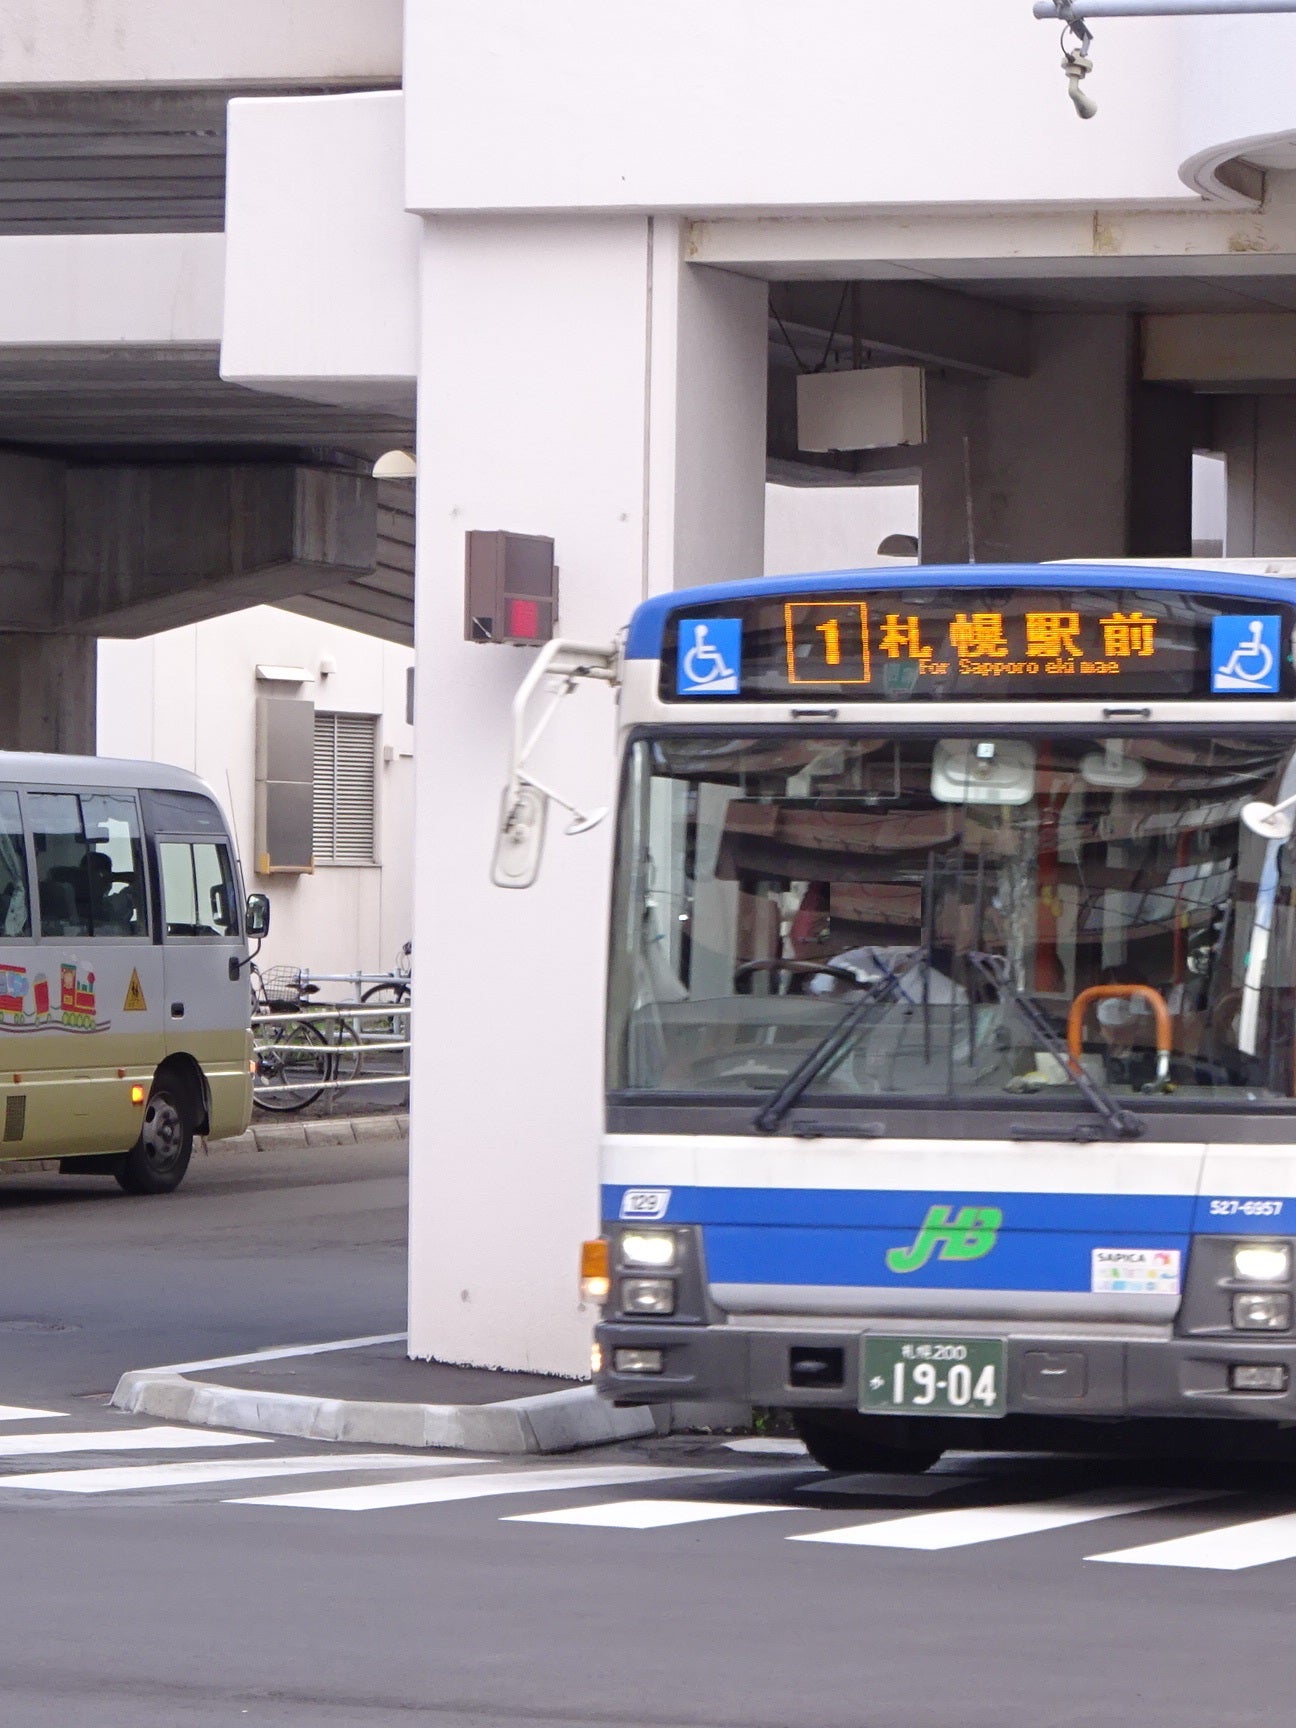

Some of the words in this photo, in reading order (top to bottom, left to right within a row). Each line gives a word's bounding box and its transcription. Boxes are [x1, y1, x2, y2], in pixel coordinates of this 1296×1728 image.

[815, 618, 841, 665] 1
[879, 612, 1158, 658] 札幌駅前
[918, 658, 951, 675] For
[958, 658, 1040, 677] Sapporo
[1045, 657, 1076, 675] eki
[1079, 660, 1120, 675] mae
[629, 1194, 659, 1211] 129
[1208, 1199, 1284, 1216] 527-6957
[1096, 1252, 1147, 1264] SAPICA
[892, 1361, 998, 1407] 19-04
